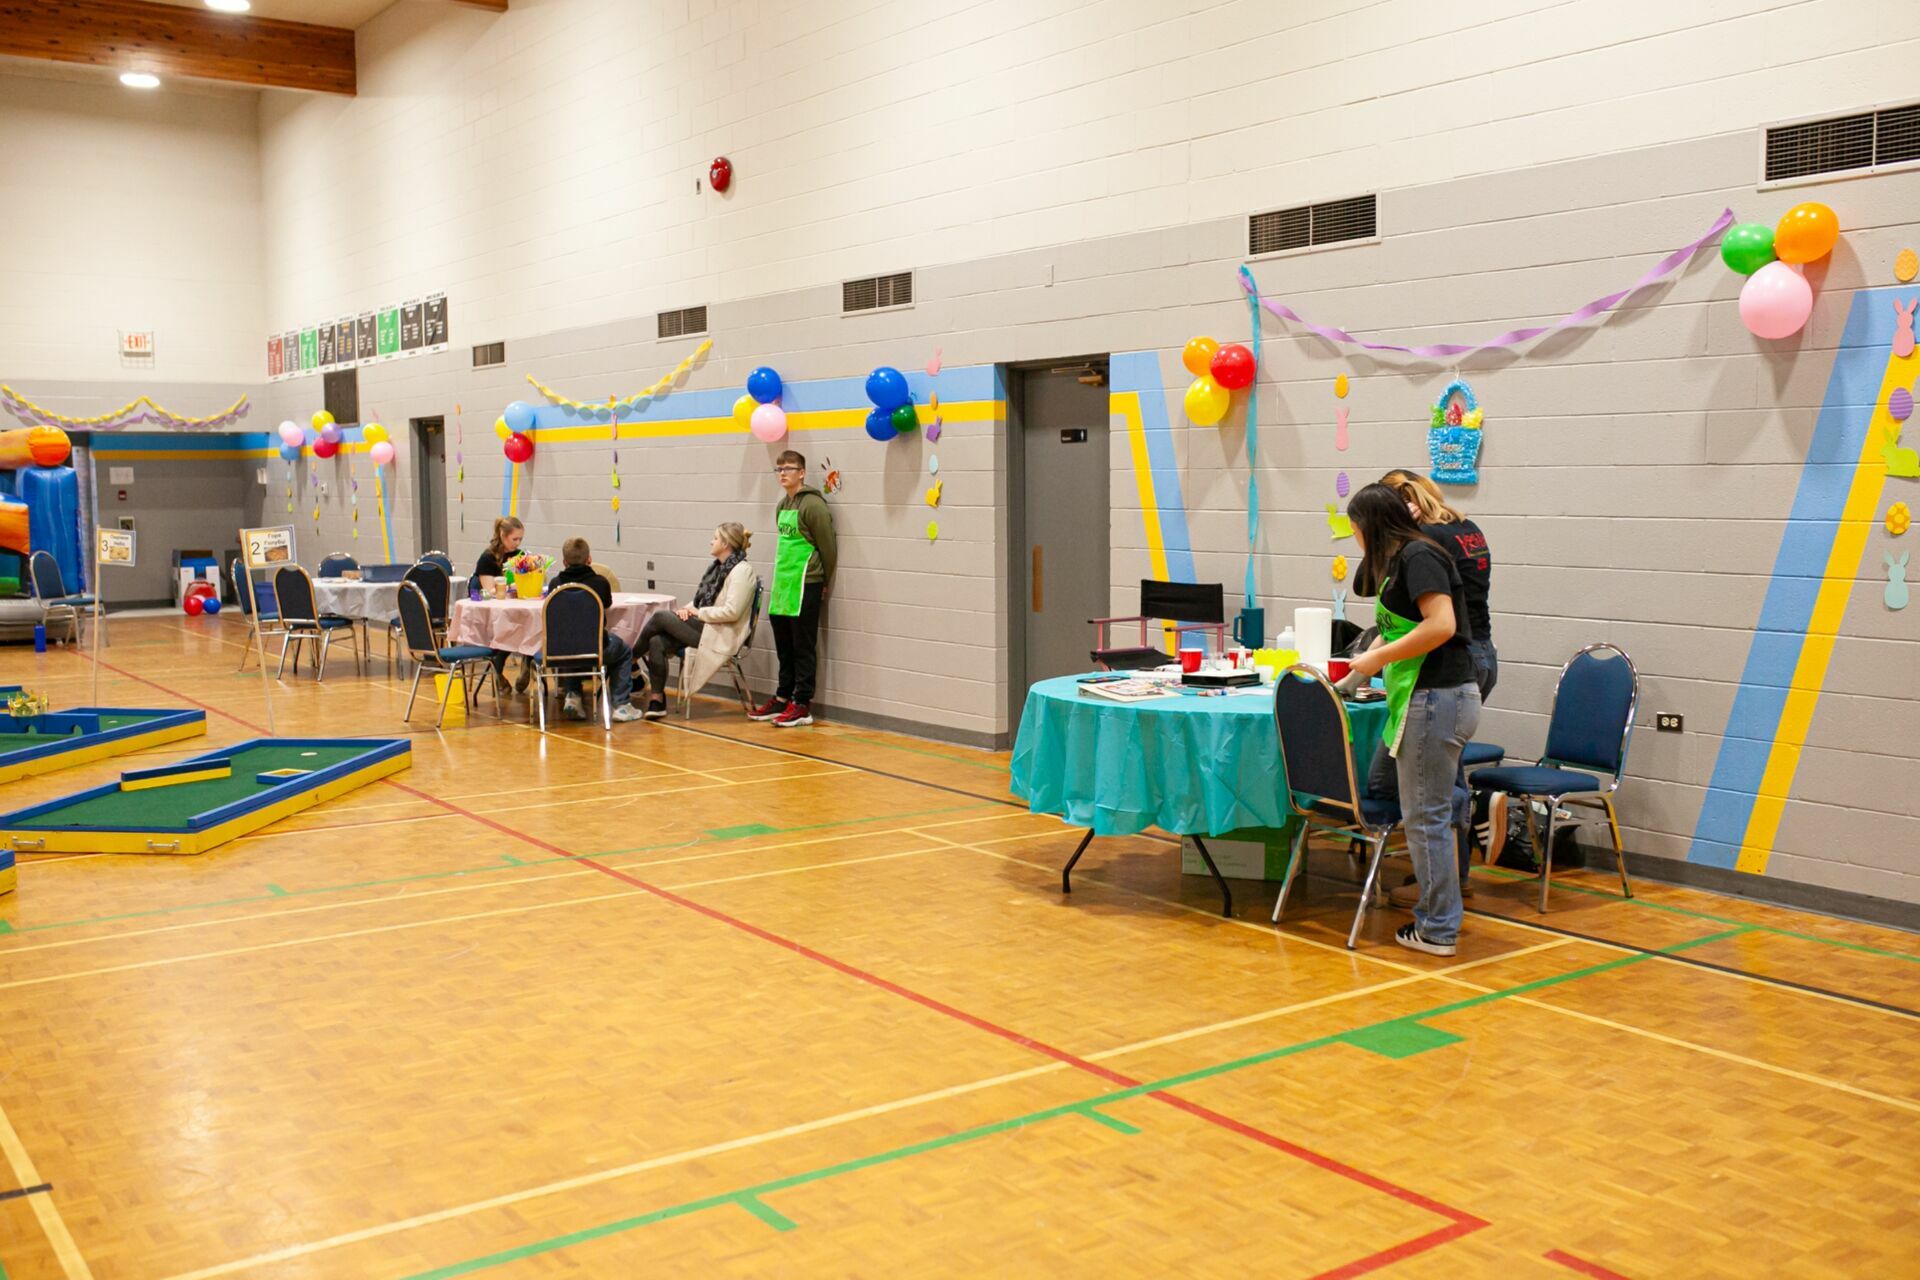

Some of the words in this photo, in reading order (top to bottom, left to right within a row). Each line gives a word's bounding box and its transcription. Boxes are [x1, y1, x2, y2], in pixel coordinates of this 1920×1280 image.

[128, 335, 147, 349] EXIT
[102, 539, 109, 552] 3
[251, 541, 261, 555] 2
